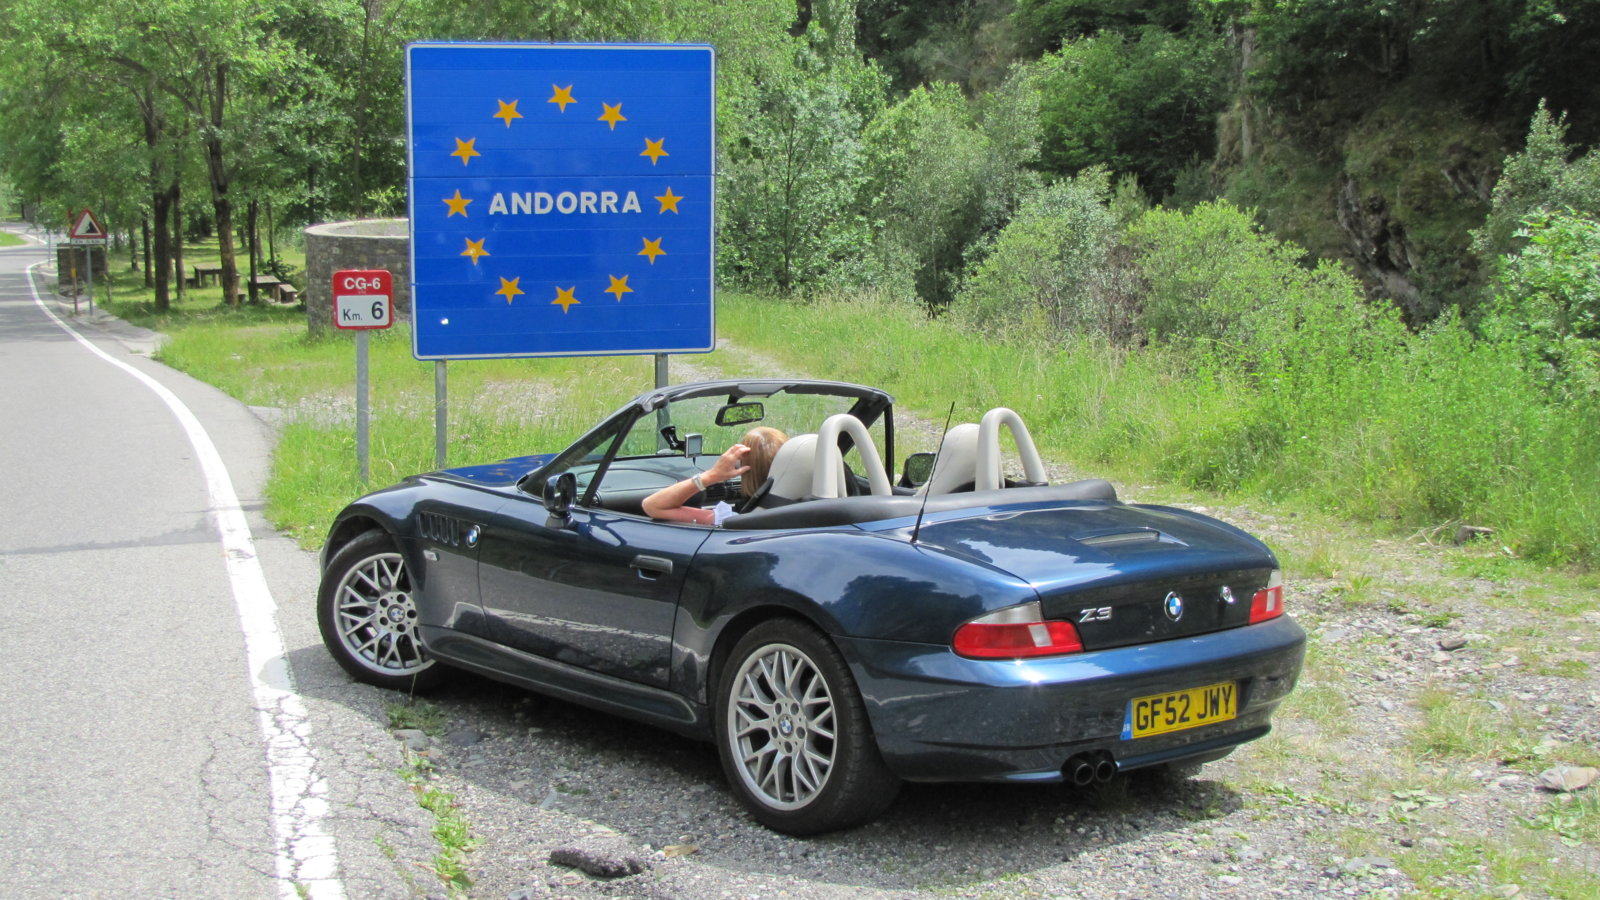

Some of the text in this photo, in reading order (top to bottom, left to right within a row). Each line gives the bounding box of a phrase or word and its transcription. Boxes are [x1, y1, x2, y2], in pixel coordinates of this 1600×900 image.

[488, 191, 642, 215] ANDORRA
[344, 277, 381, 290] CG-6
[371, 301, 384, 320] 6
[1079, 606, 1112, 623] Z3
[1136, 685, 1233, 731] GF52 JWY
